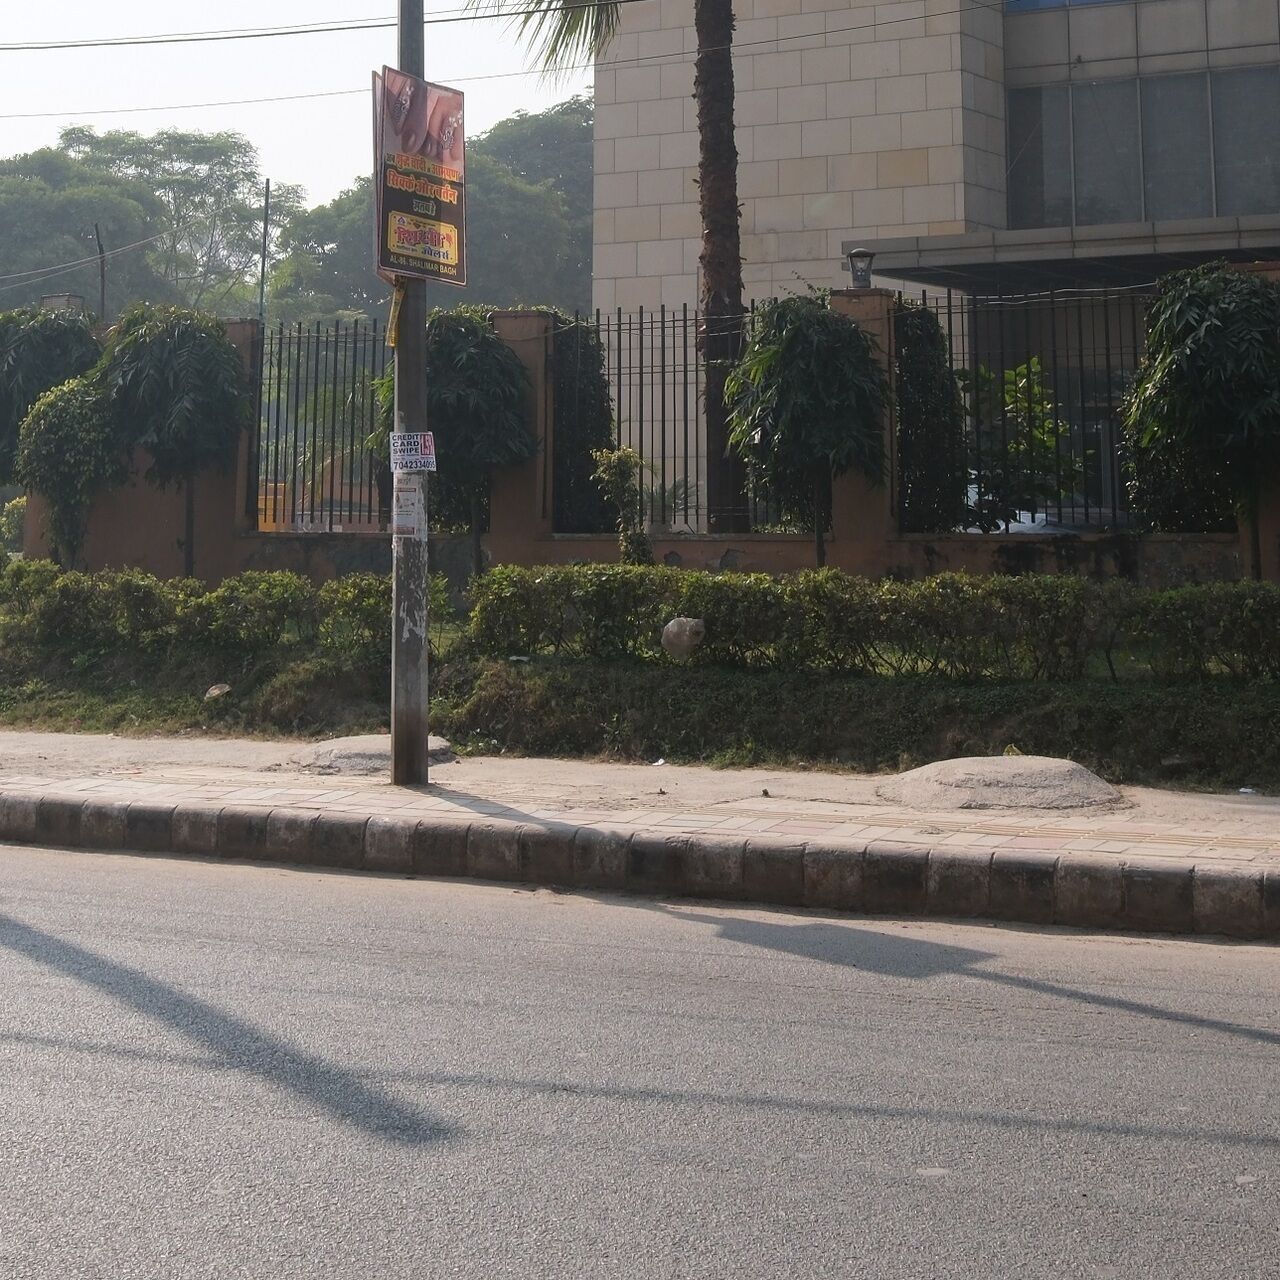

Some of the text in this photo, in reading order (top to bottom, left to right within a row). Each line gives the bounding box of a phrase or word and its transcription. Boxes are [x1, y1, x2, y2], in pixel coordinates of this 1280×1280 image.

[439, 265, 457, 276] BAGH
[392, 440, 420, 448] CARD
[392, 447, 420, 455] SWIPE
